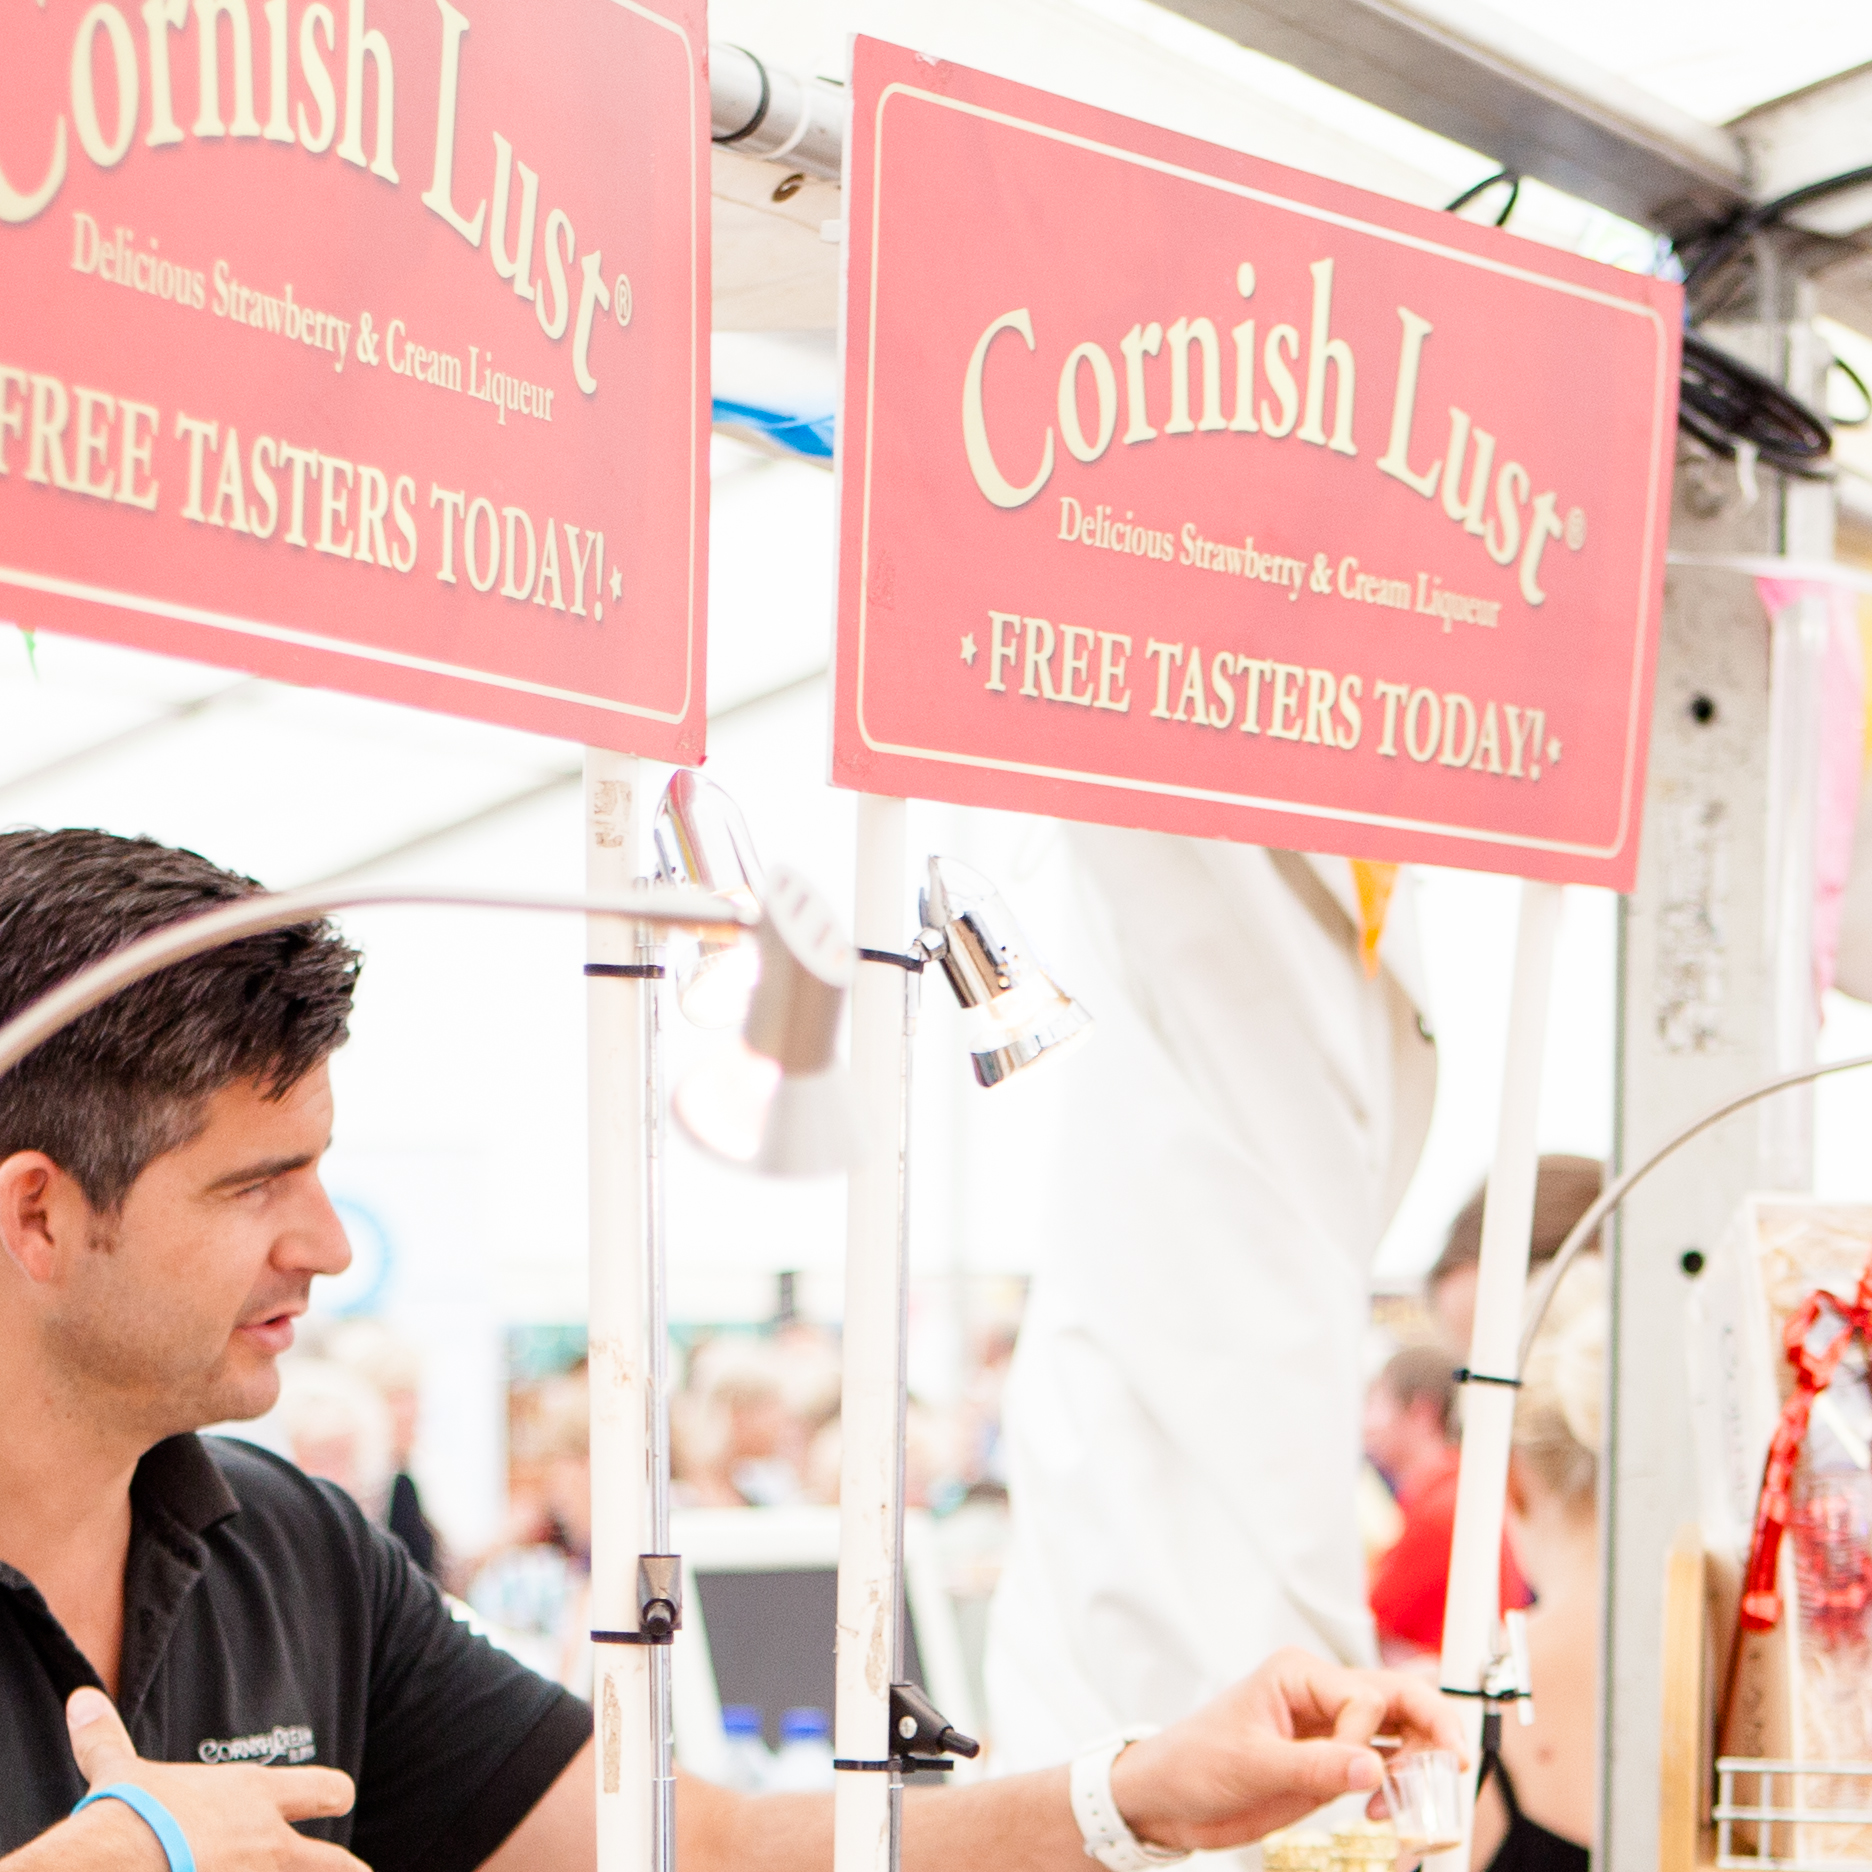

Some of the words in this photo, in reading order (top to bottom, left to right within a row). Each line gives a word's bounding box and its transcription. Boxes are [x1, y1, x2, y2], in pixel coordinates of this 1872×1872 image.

[70, 211, 207, 311] Delicious
[211, 260, 352, 372] Strawberry
[355, 311, 380, 366] &
[385, 319, 463, 392] Cream
[467, 345, 556, 427] Liqueur
[961, 257, 1359, 510] Cornish
[176, 410, 420, 576] TASTERS
[429, 482, 608, 621] TODAY!
[1057, 496, 1175, 564] Delicious
[1179, 523, 1308, 602] Strawberry
[1309, 552, 1334, 595] &
[1337, 556, 1412, 613] Cream
[1415, 574, 1503, 634] Liqueur
[984, 610, 1134, 714] FREE
[1145, 637, 1365, 752] TASTERS
[1374, 678, 1546, 782] TODAY!
